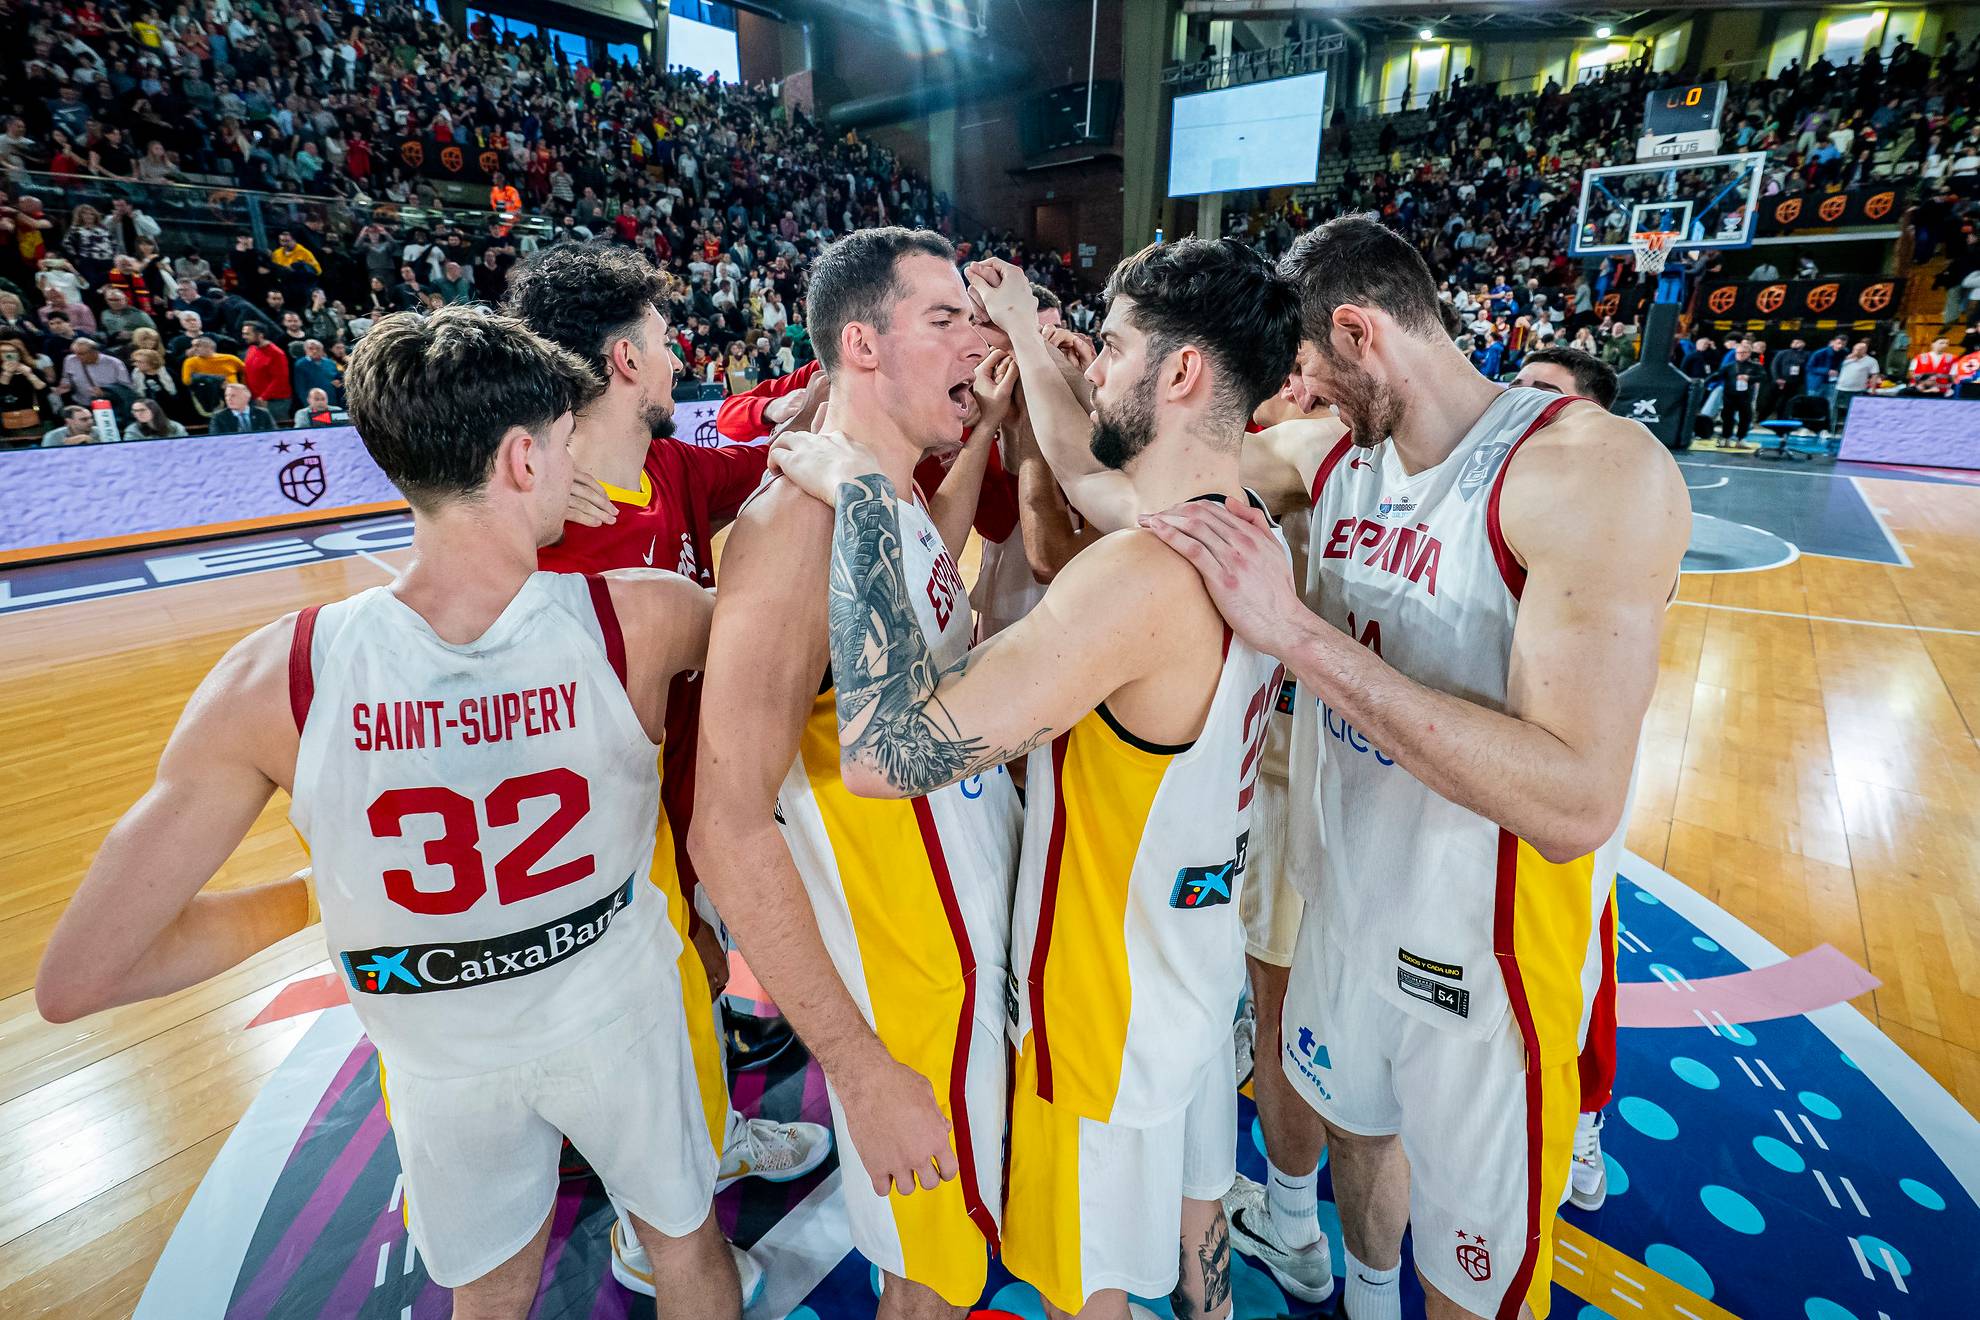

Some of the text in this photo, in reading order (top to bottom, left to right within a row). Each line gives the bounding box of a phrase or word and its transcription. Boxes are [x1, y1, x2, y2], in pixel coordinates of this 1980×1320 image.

[1653, 142, 1699, 157] LOTUS
[1323, 516, 1442, 596] EPAÑA
[352, 680, 577, 751] SAINT-SUPERY
[366, 767, 595, 915] 32
[417, 889, 626, 985] CaixaBank
[1402, 953, 1421, 966] TODOS
[1426, 963, 1444, 973] CADA
[1444, 968, 1460, 976] UNO
[1438, 989, 1455, 1005] 54
